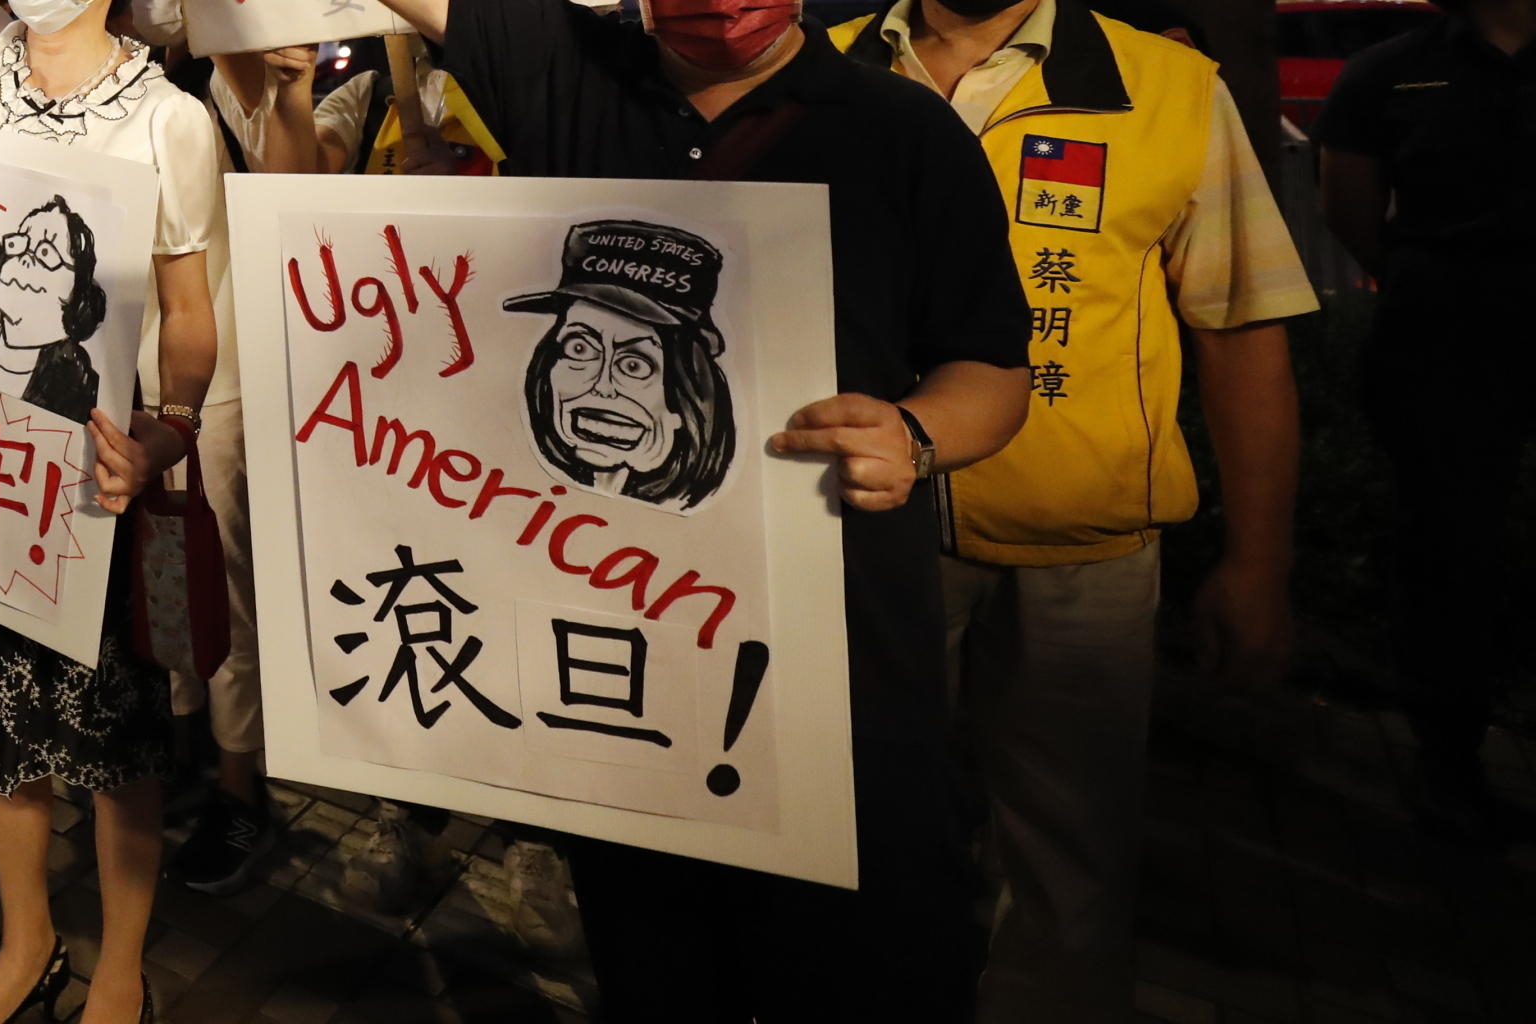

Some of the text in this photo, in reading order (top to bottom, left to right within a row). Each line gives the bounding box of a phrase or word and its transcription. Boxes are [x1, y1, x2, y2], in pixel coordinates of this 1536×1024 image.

[1033, 188, 1084, 219] 新黨
[588, 234, 705, 267] UNITED STATES
[581, 255, 692, 294] CONGRESS
[286, 223, 477, 380] Ugly
[294, 360, 738, 650] American
